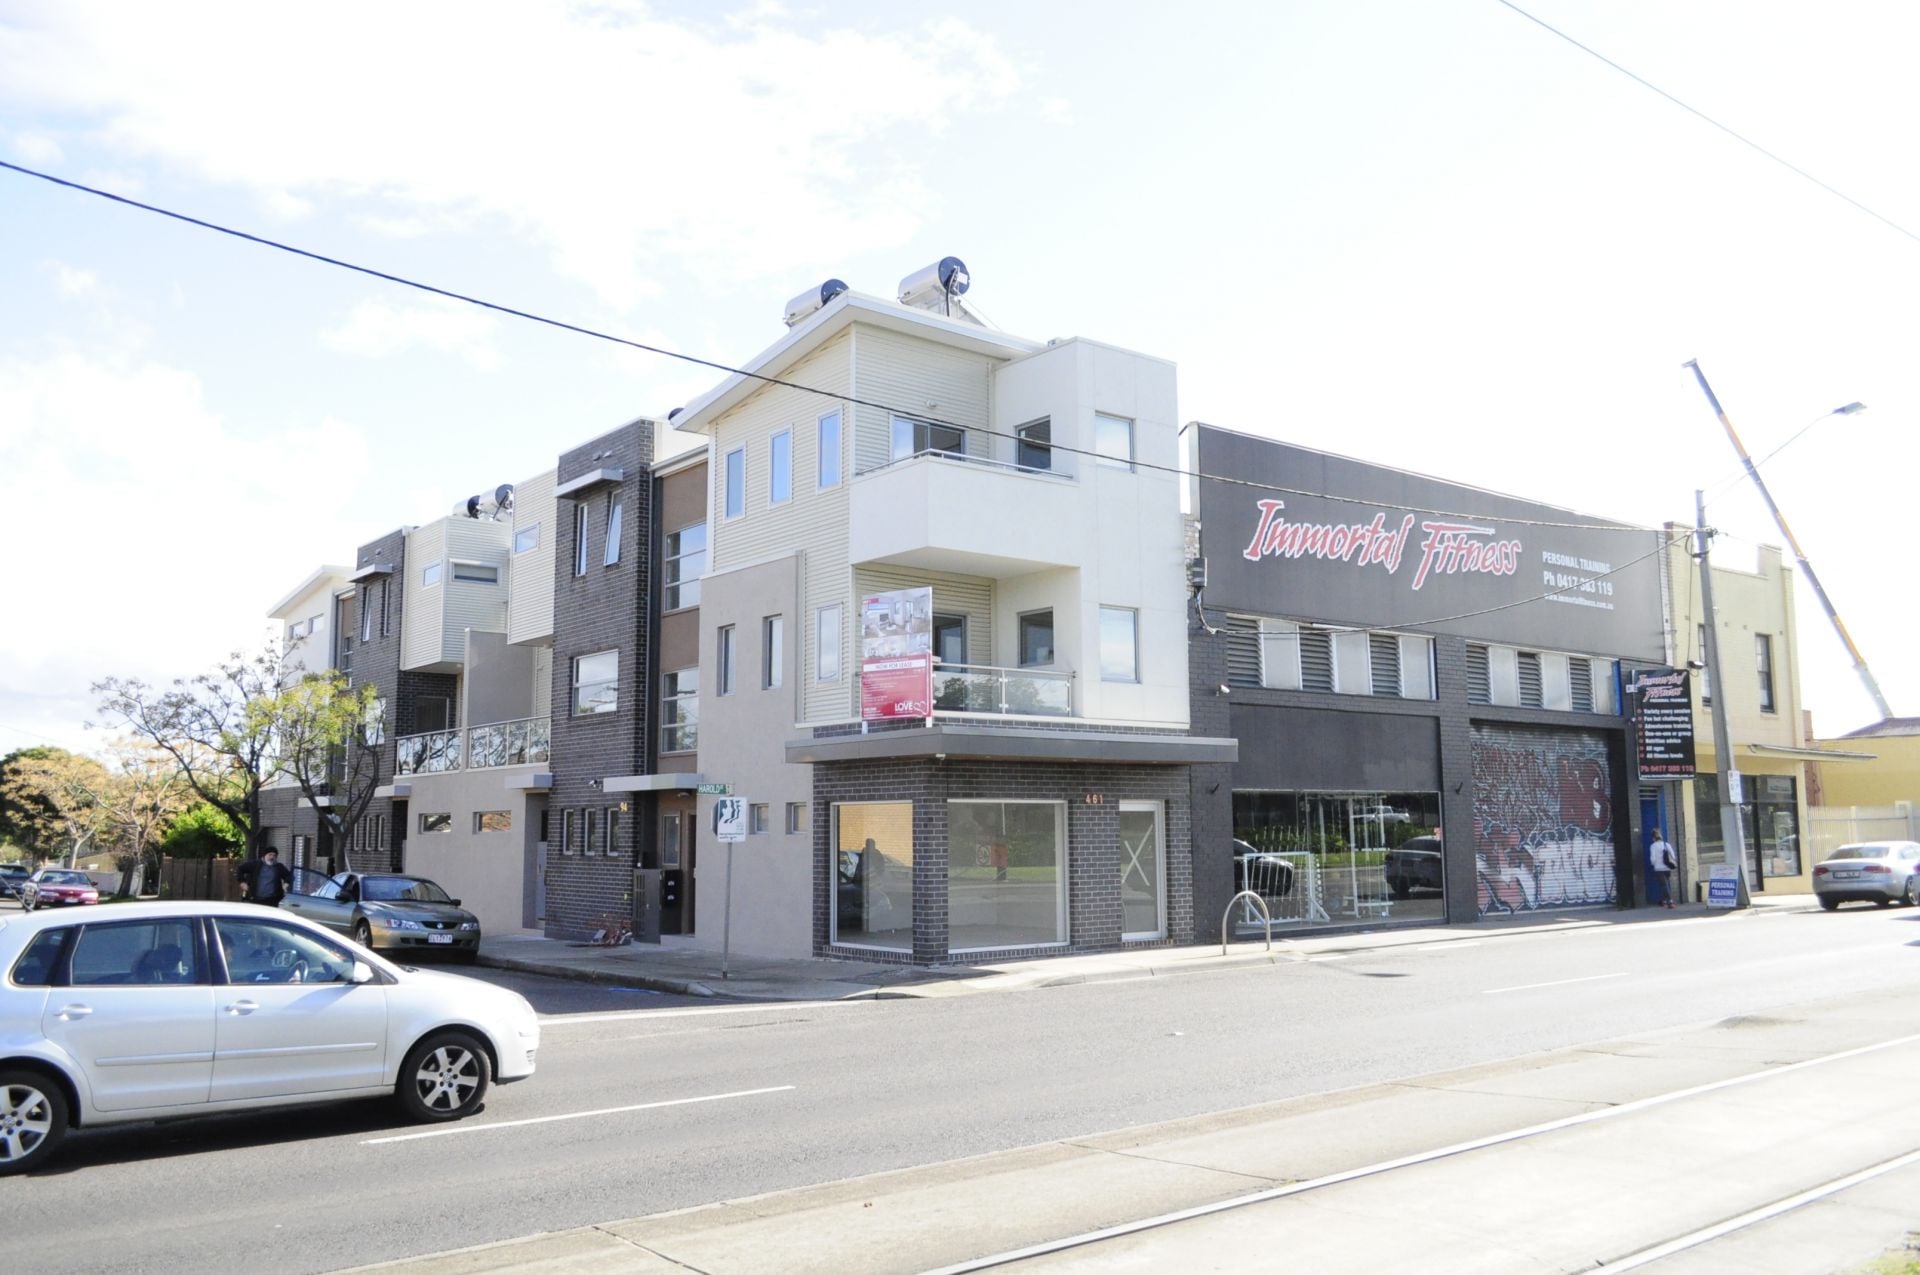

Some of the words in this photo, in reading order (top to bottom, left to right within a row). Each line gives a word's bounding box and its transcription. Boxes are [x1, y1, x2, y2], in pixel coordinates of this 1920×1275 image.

[1243, 499, 1415, 574] Immortal
[1412, 521, 1521, 590] Fitness
[1542, 551, 1580, 569] PERSONAL
[1580, 558, 1611, 574] TRAINING
[1543, 570, 1555, 587] Ph
[1556, 573, 1579, 590] 0417
[1597, 580, 1614, 596] 119
[894, 700, 913, 712] LOVE
[698, 783, 720, 794] HAROLD
[1085, 793, 1103, 804] 461
[1711, 881, 1735, 889] PERSONAL
